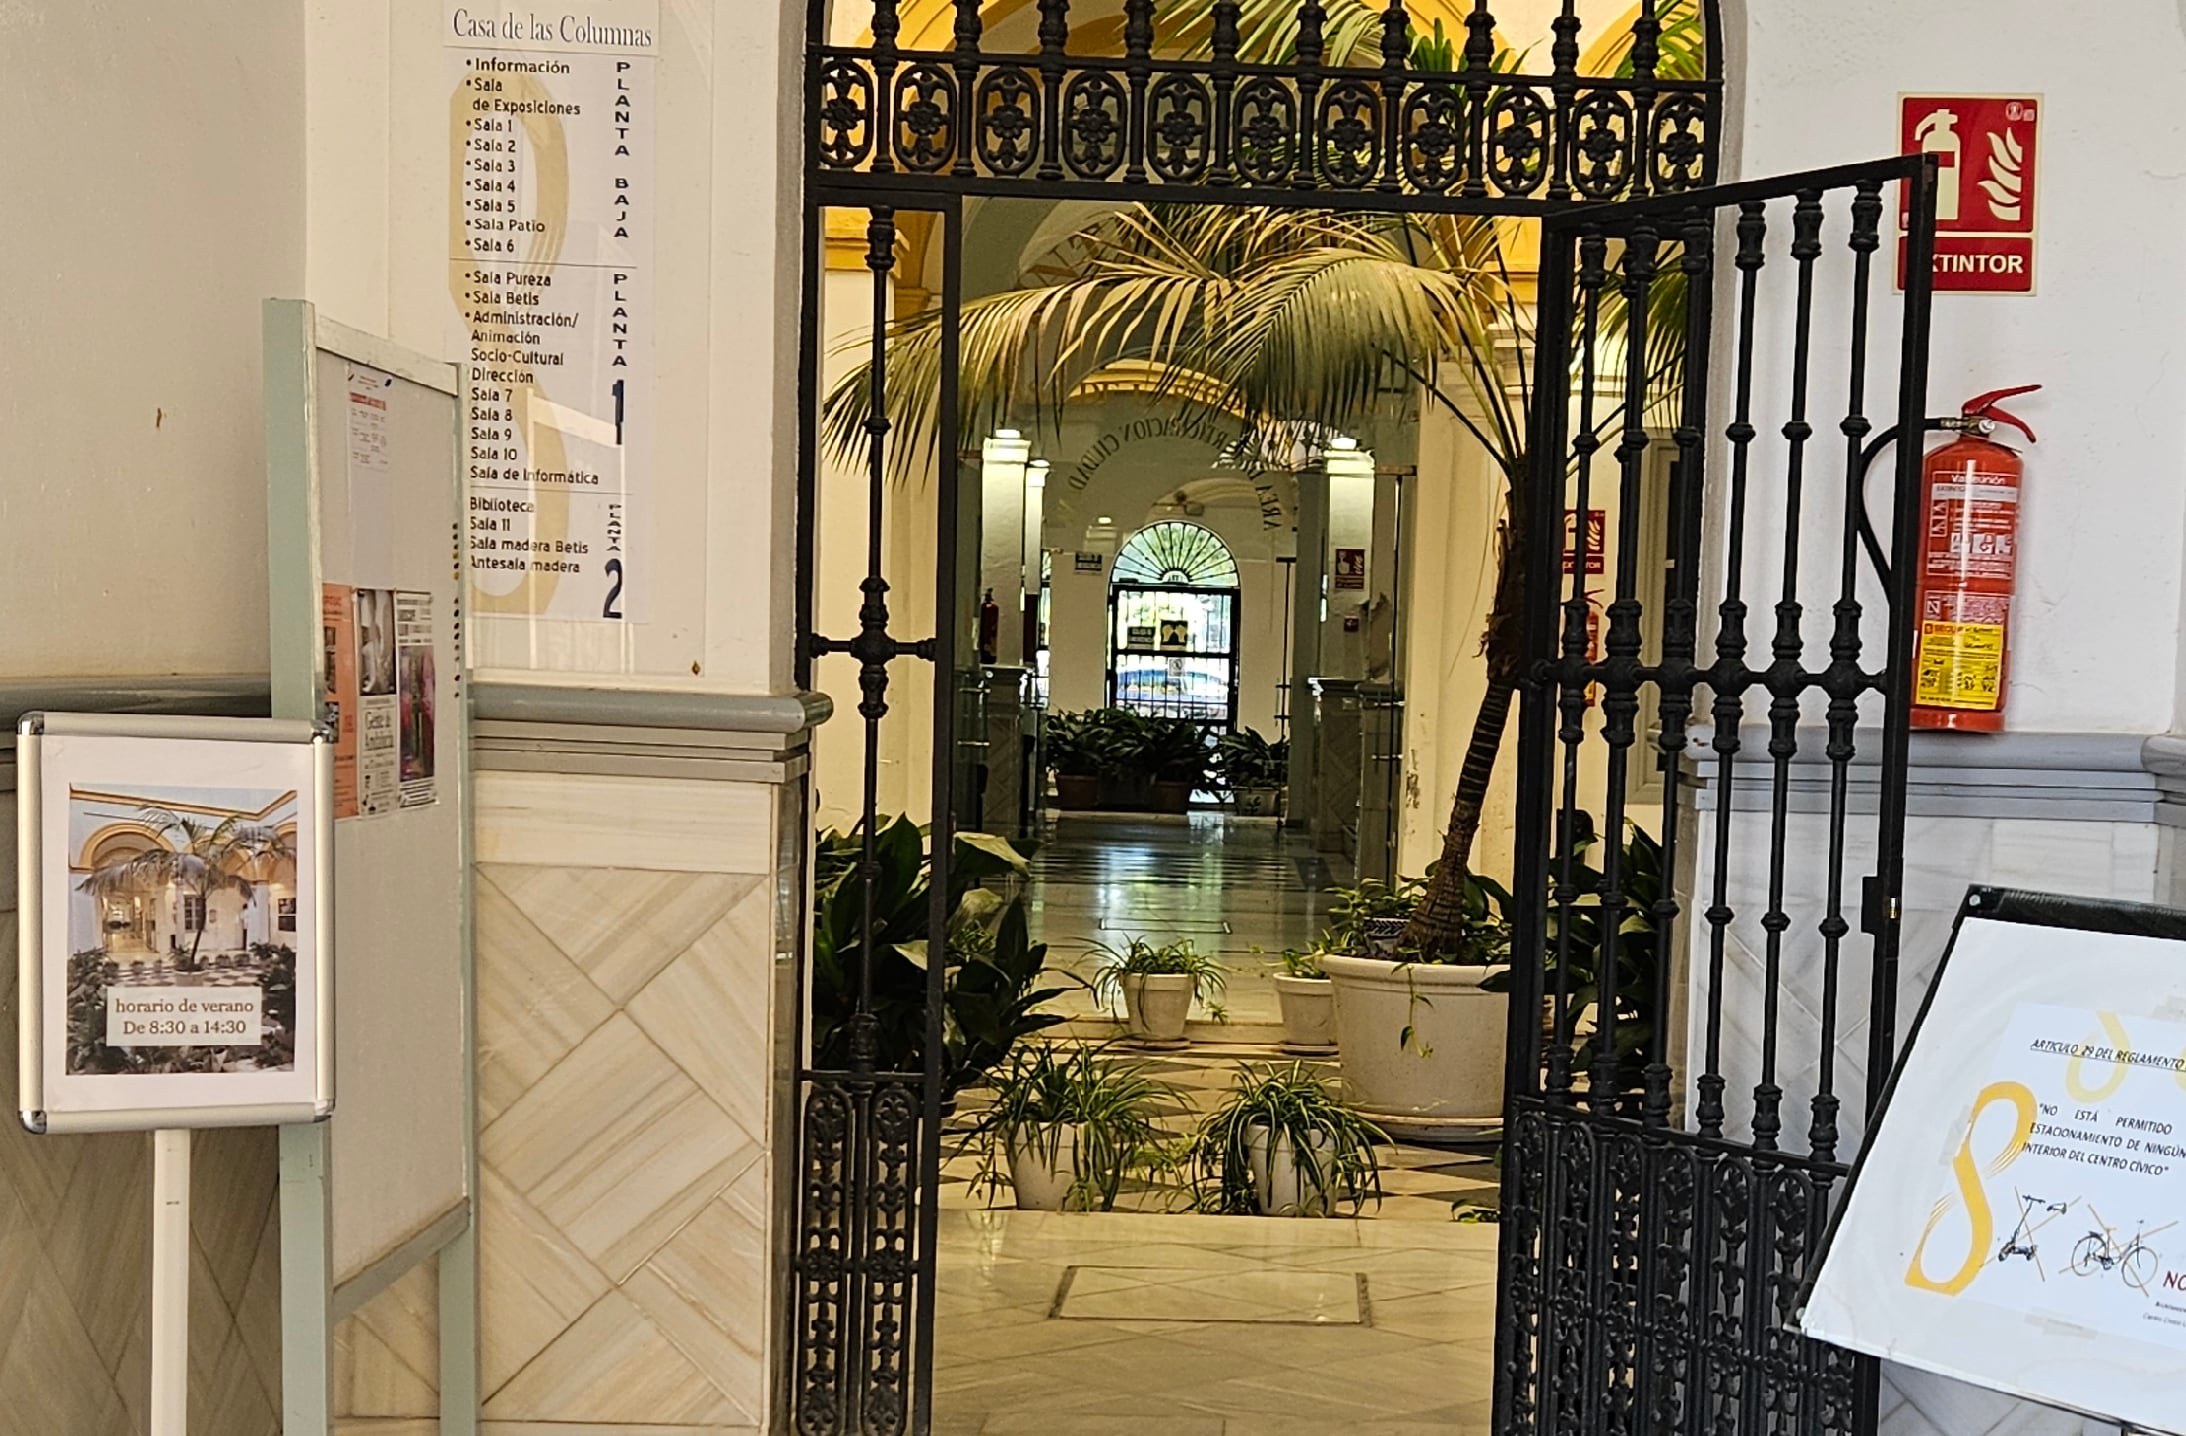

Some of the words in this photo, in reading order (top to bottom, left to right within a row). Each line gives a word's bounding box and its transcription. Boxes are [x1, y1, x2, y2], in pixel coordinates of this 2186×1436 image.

[453, 8, 496, 38] Casa
[502, 12, 523, 40] de
[530, 13, 553, 41] las
[560, 15, 652, 47] Columnas
[475, 57, 570, 74] Información
[474, 77, 503, 92] Sala
[472, 97, 490, 111] de
[494, 99, 581, 116] Exposiciones
[615, 62, 631, 156] PLANTA
[474, 118, 503, 131] Sala
[474, 138, 503, 152] Sala
[508, 139, 516, 153] 2
[474, 158, 503, 172] Sala
[507, 159, 516, 173] 3
[474, 178, 503, 192] Sala
[507, 179, 516, 193] 4
[474, 198, 503, 212] Sala
[507, 199, 516, 213] 5
[613, 178, 630, 238] BAJA
[474, 218, 503, 231] Sala
[509, 219, 545, 233] Patio
[473, 238, 502, 251] Sala
[506, 239, 514, 253] 6
[1932, 254, 2023, 274] TINTOR
[473, 270, 501, 284] Sala
[506, 272, 551, 287] Pureza
[473, 291, 501, 304] Sala
[506, 292, 539, 305] Betis
[612, 273, 628, 367] PLANTA
[471, 330, 541, 345] Animación
[471, 348, 564, 366] Socio-Cultural
[472, 368, 533, 384] Dirección
[471, 387, 500, 401] Sala
[505, 389, 513, 402] 7
[471, 407, 500, 421] Sala
[504, 409, 513, 422] 8
[471, 427, 500, 440] Sala
[504, 428, 512, 441] 9
[470, 446, 499, 460] Sala
[503, 448, 518, 461] 10
[470, 466, 499, 480] Sala
[503, 467, 519, 481] de
[523, 468, 599, 485] Informática
[470, 496, 535, 513] Biblioteca
[470, 516, 497, 531] Sala
[502, 517, 511, 531] 11
[470, 536, 497, 550] Sala
[501, 538, 550, 552] madera
[555, 540, 588, 554] Betis
[530, 560, 580, 573] madera
[602, 558, 623, 619] 2
[115, 998, 174, 1013] horario
[178, 998, 197, 1013] de
[201, 1001, 254, 1013] verano
[123, 1021, 146, 1035] De
[149, 1020, 186, 1035] 8:30
[190, 1024, 199, 1034] a
[204, 1020, 247, 1034] 14:30
[2095, 1047, 2113, 1059] DEL
[2115, 1050, 2185, 1070] REGLAMENTO
[2074, 1109, 2098, 1122] ESTÁ
[2115, 1116, 2173, 1135] PERMITIDO
[2030, 1122, 2123, 1148] ESTACIONAMIENTO
[2126, 1138, 2141, 1151] DE
[2022, 1142, 2067, 1159] INTERIOR
[2069, 1150, 2085, 1163] DEL
[2087, 1153, 2128, 1170] CENTRO
